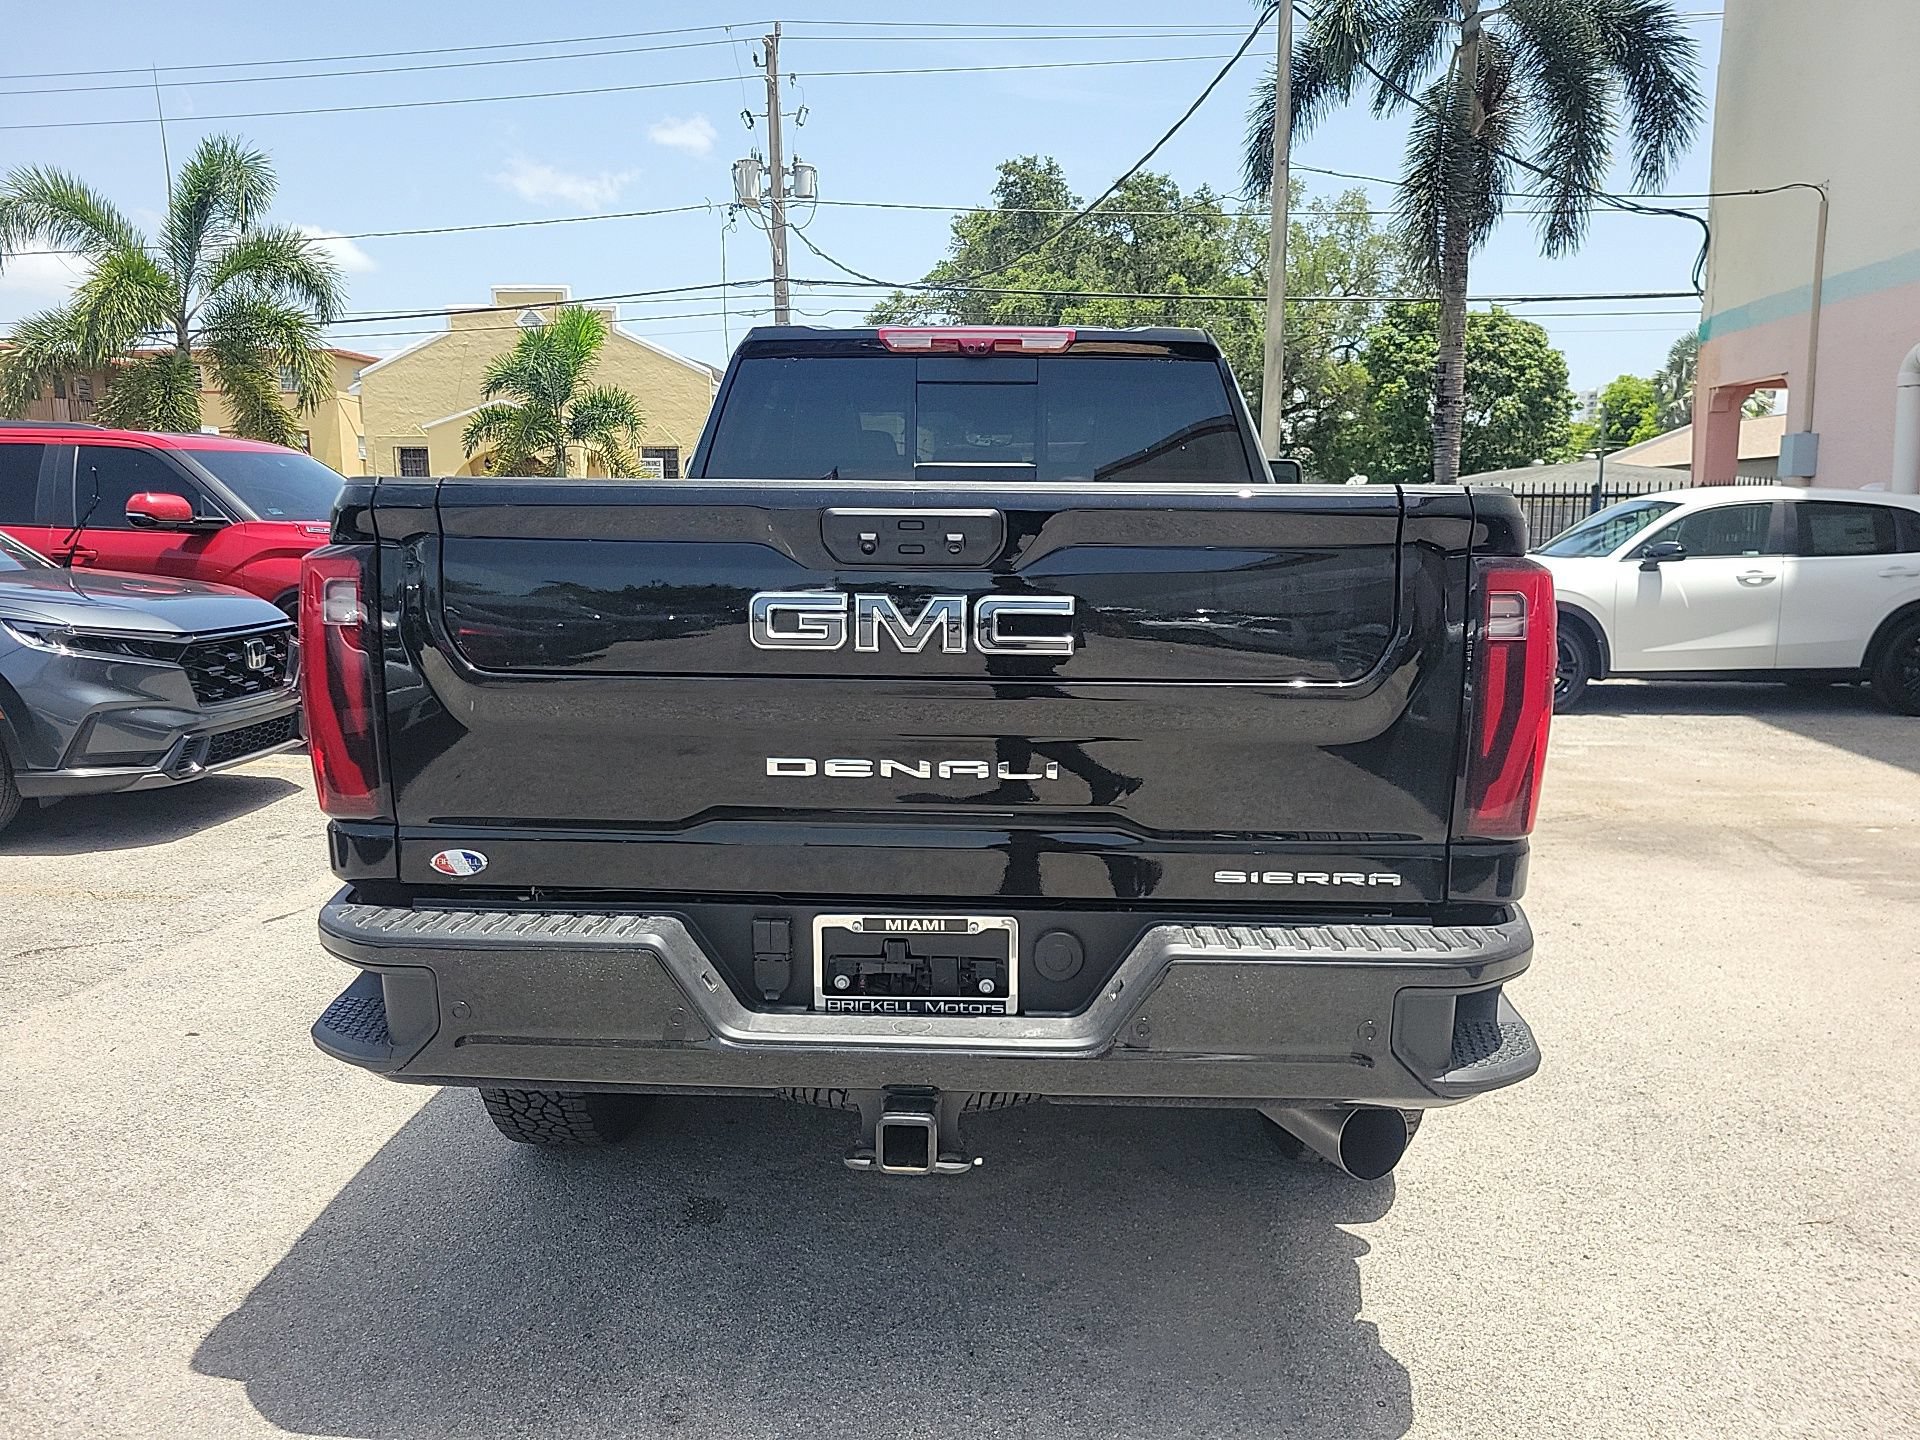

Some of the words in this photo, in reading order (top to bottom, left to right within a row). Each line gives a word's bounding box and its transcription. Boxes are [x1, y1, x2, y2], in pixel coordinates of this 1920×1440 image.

[748, 590, 1076, 656] GMC
[765, 757, 1060, 780] DENALI
[1213, 869, 1403, 887] SIERRA
[884, 919, 946, 931] MIAMI
[827, 1000, 919, 1013] BRICKELL
[925, 1001, 1005, 1014] Motors
